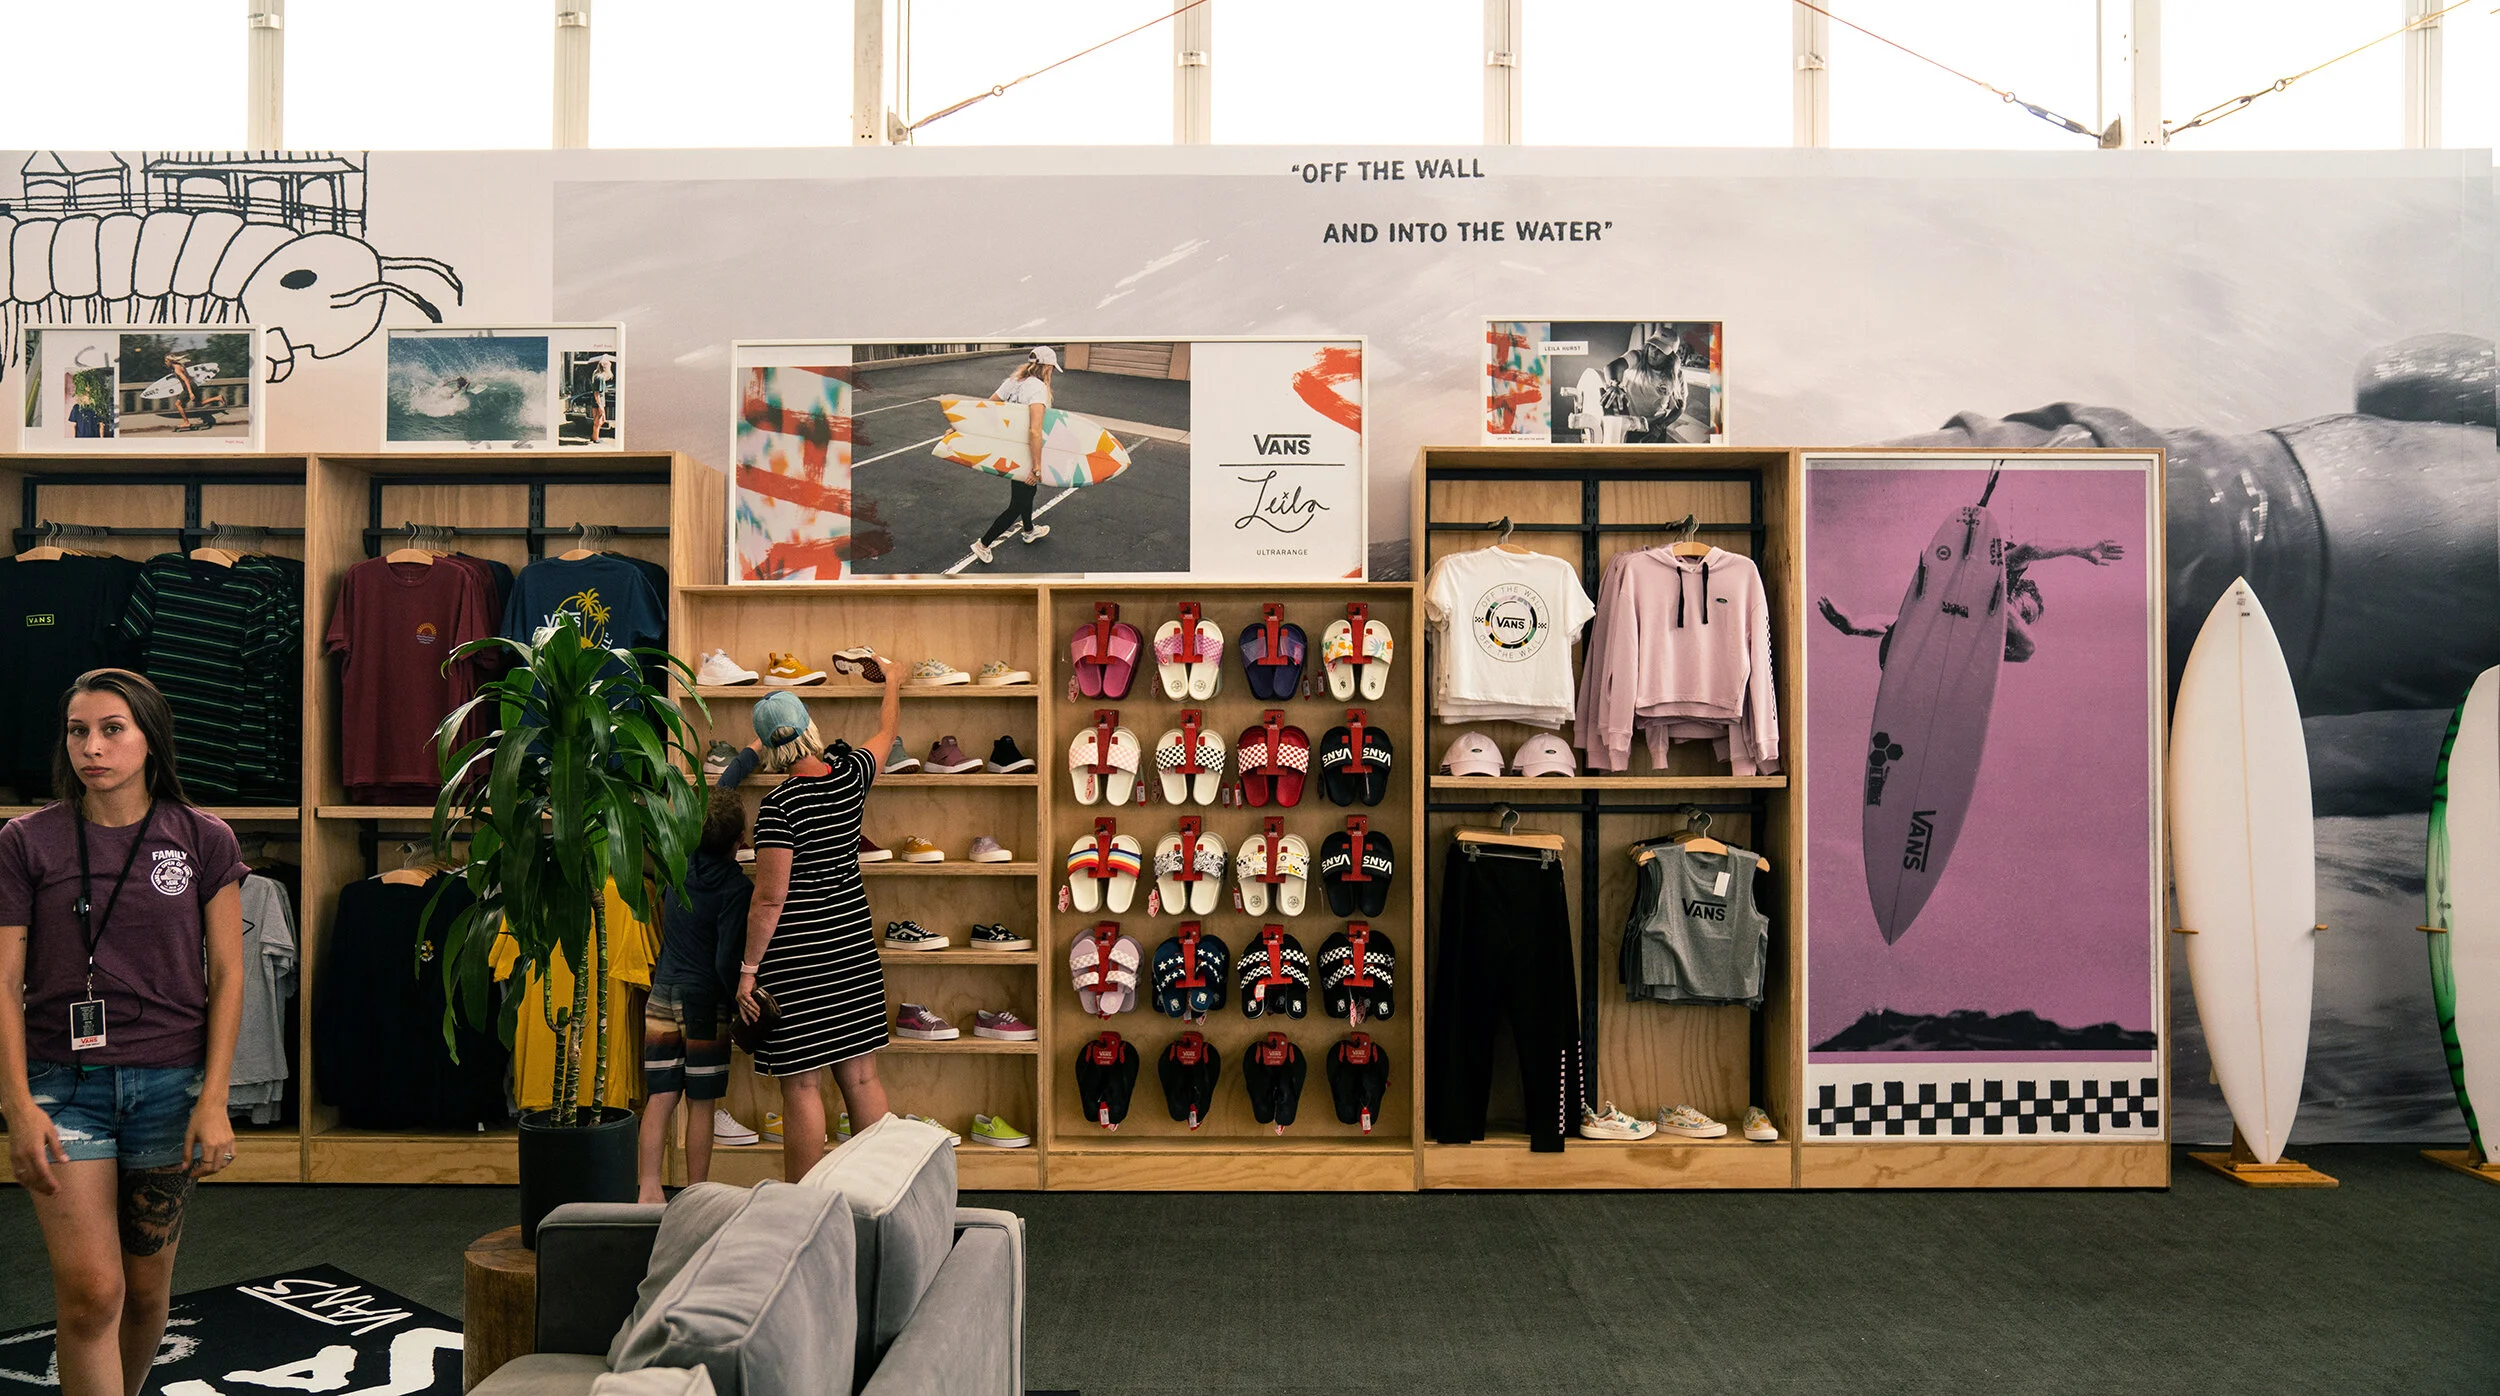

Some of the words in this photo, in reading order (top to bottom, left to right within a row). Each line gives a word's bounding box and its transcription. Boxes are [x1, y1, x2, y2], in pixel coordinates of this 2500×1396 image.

[1291, 162, 1348, 183] “OFF
[1357, 160, 1405, 181] THE
[1415, 158, 1485, 179] WALL
[1323, 222, 1378, 243] AND
[1389, 222, 1447, 243] INTO
[1457, 221, 1505, 242] THE
[1516, 220, 1613, 242] WATER”
[1253, 433, 1312, 455] VANS
[1481, 592, 1496, 608] OFF
[1524, 589, 1544, 612] WALL
[28, 616, 52, 624] VANS
[1496, 616, 1526, 629] VANS
[1479, 634, 1493, 649] OFF
[1497, 649, 1514, 659] THE
[1519, 639, 1541, 657] WALL
[1321, 747, 1353, 768] VANS
[1362, 747, 1391, 767] VANS
[1903, 810, 1937, 873] VANS
[152, 850, 188, 861] FAMILY
[1321, 853, 1351, 874] VANS
[1362, 855, 1393, 875] VANS
[1681, 897, 1727, 921] VANS
[236, 1278, 413, 1336] VANS
